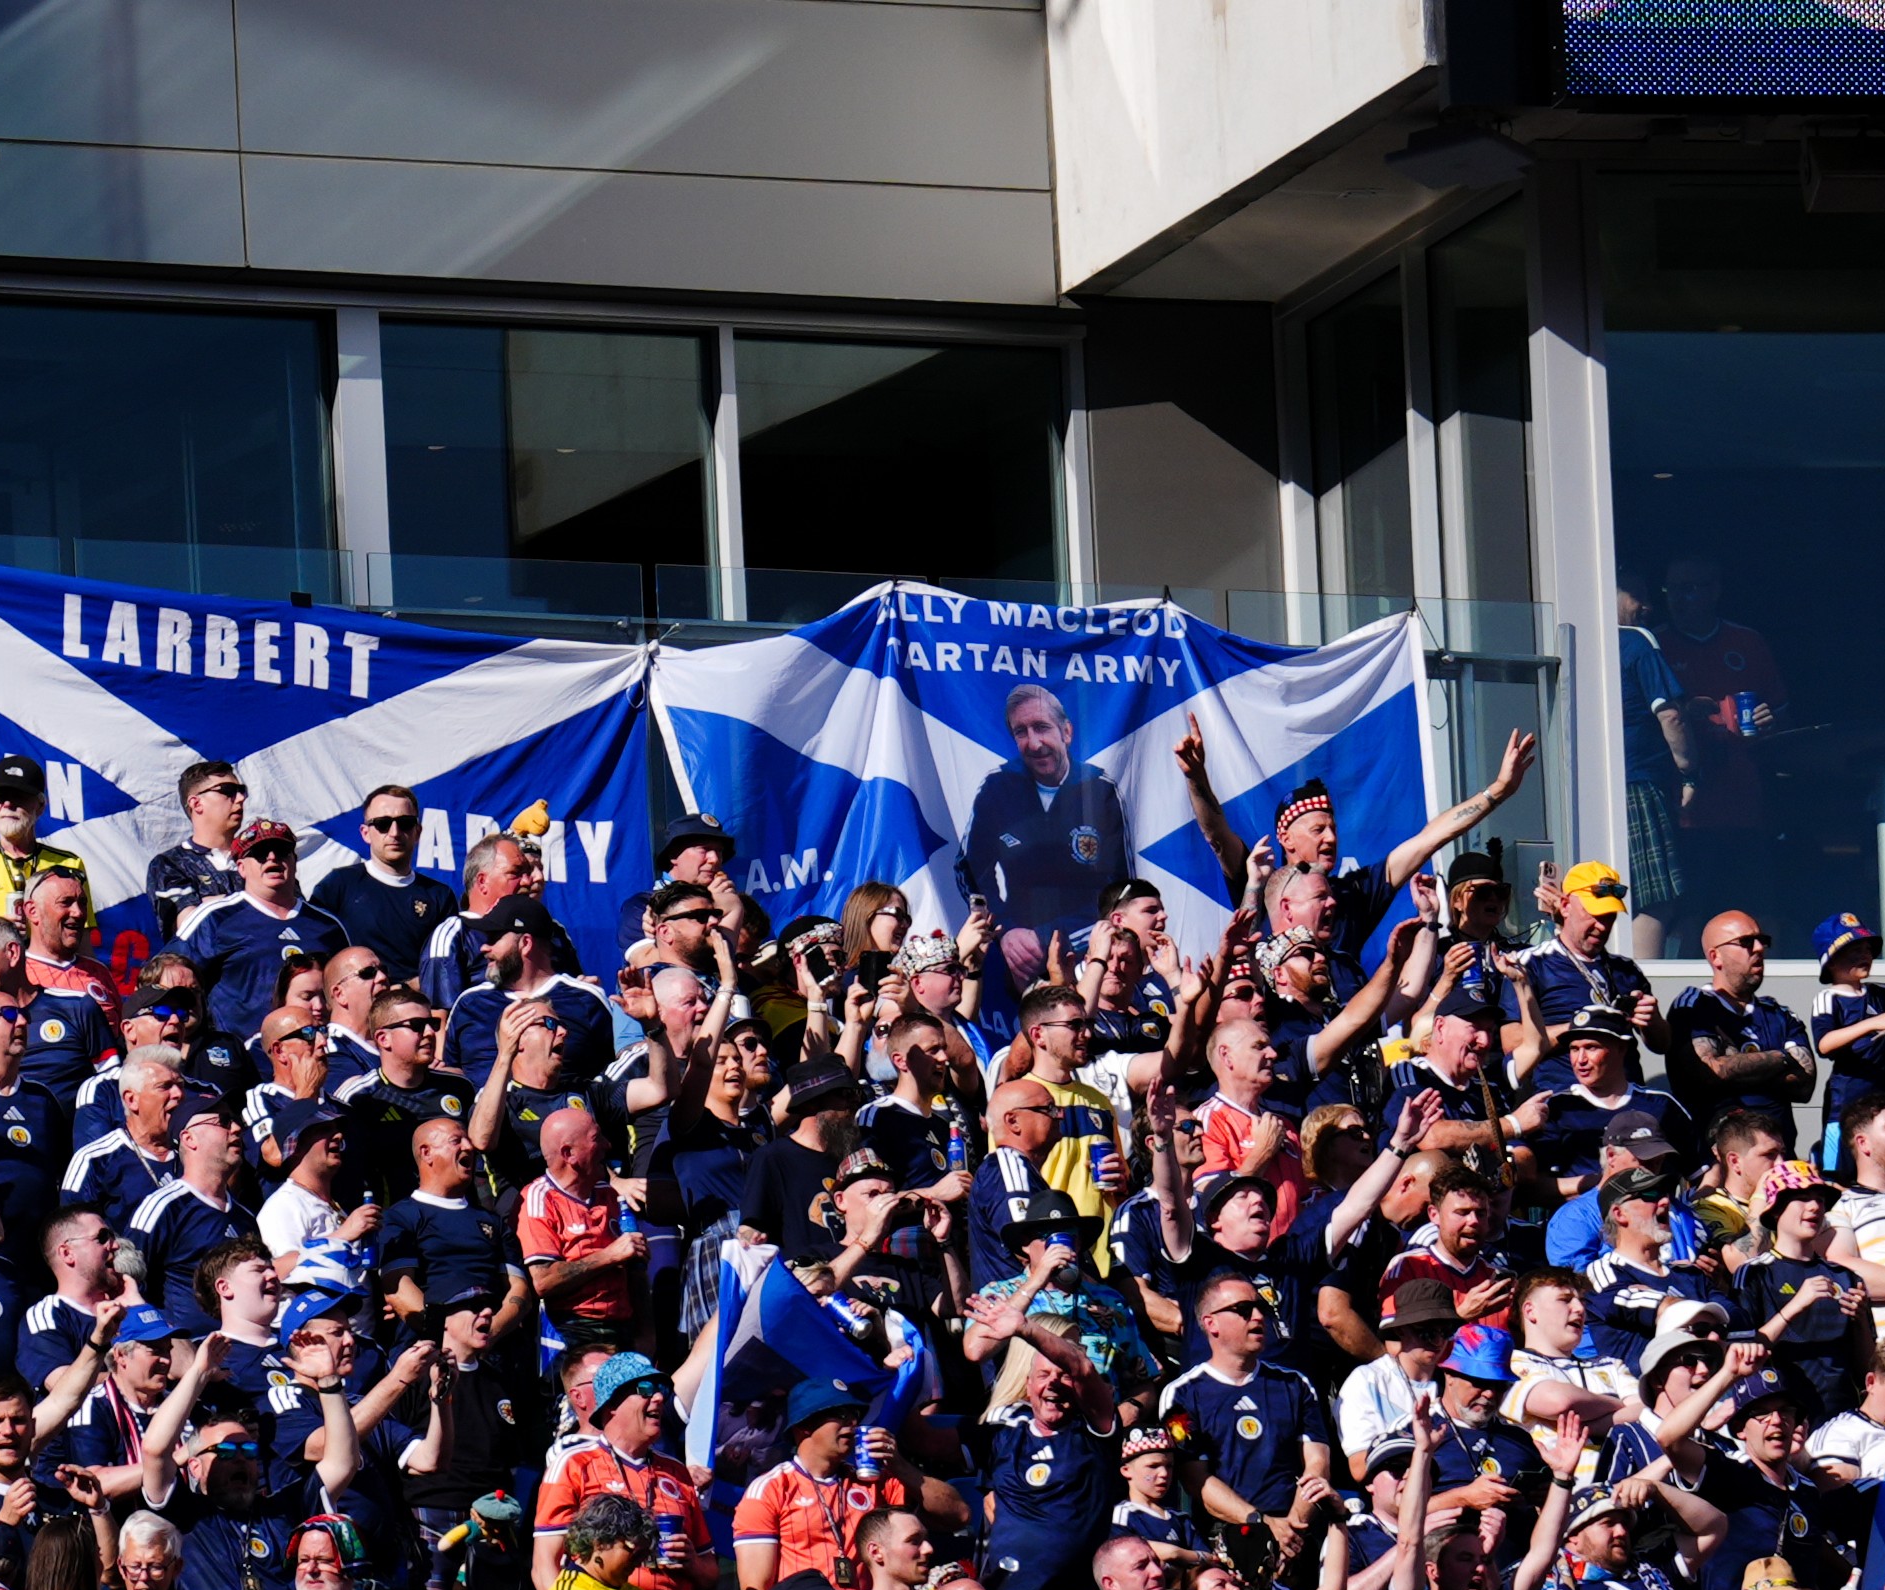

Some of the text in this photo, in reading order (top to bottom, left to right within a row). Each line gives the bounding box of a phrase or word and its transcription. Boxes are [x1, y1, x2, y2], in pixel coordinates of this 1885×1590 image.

[987, 601, 1187, 643] MACLEOD
[63, 593, 380, 699] LARBERT
[1065, 661, 1182, 697] ARMY
